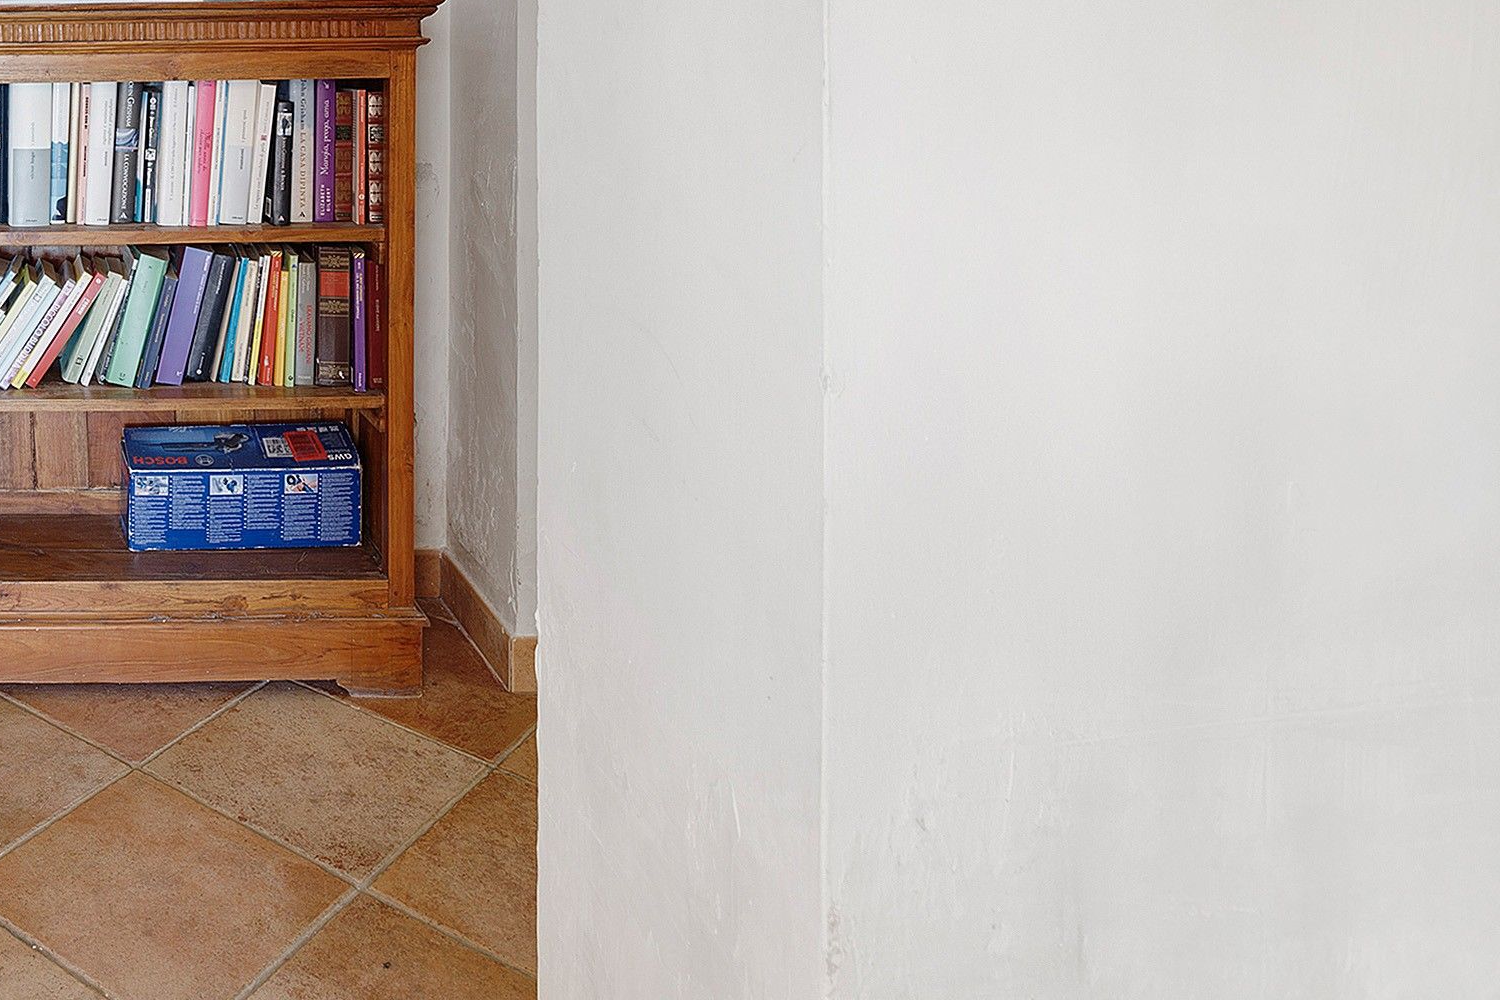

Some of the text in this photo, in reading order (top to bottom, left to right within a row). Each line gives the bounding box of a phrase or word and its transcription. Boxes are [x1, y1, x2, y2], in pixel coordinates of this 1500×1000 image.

[125, 97, 135, 127] GRISHAM
[299, 131, 306, 145] LA
[320, 143, 332, 175] Mangia,
[120, 161, 129, 210] CONVOCAZIONE
[132, 456, 188, 465] BOSCH
